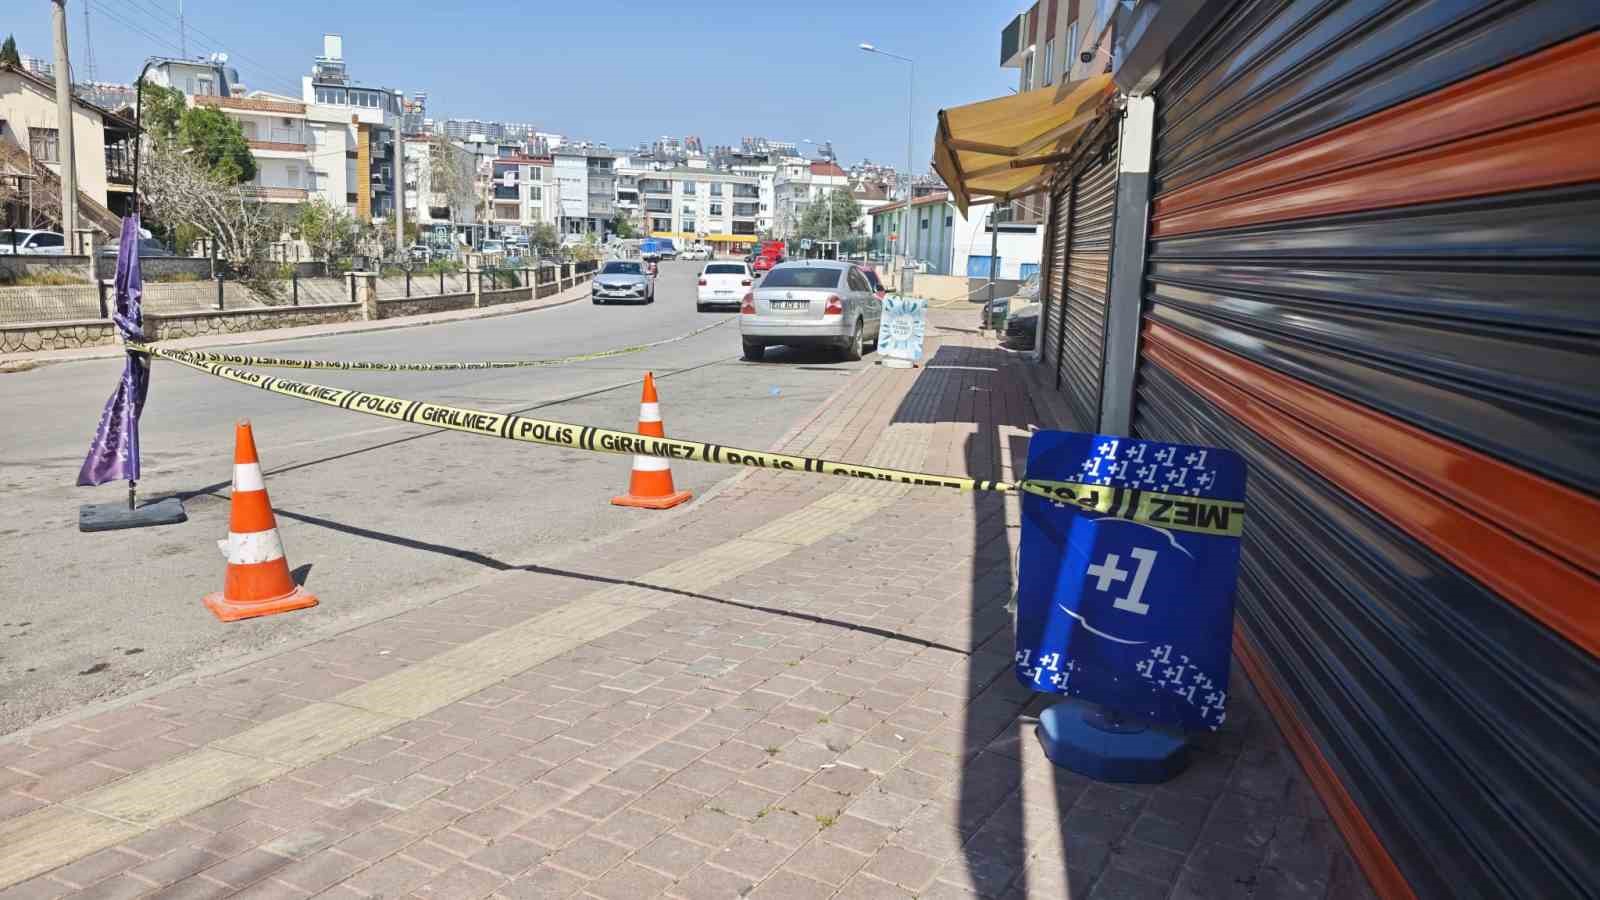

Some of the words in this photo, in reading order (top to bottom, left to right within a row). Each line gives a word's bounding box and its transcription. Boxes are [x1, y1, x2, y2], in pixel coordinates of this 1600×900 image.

[1098, 440, 1119, 460] +1
[1125, 443, 1147, 464] +1
[1154, 447, 1177, 467] +1
[1185, 450, 1208, 470] +1
[1081, 457, 1102, 477] +1
[1107, 460, 1129, 480] +1
[1136, 464, 1158, 484] +1
[1165, 468, 1187, 488] +1
[1086, 547, 1158, 616] +1
[1039, 652, 1060, 671] +1
[1150, 645, 1173, 664] +1
[1050, 671, 1070, 690] +1
[1136, 659, 1155, 678] +1
[1162, 665, 1185, 685] +1
